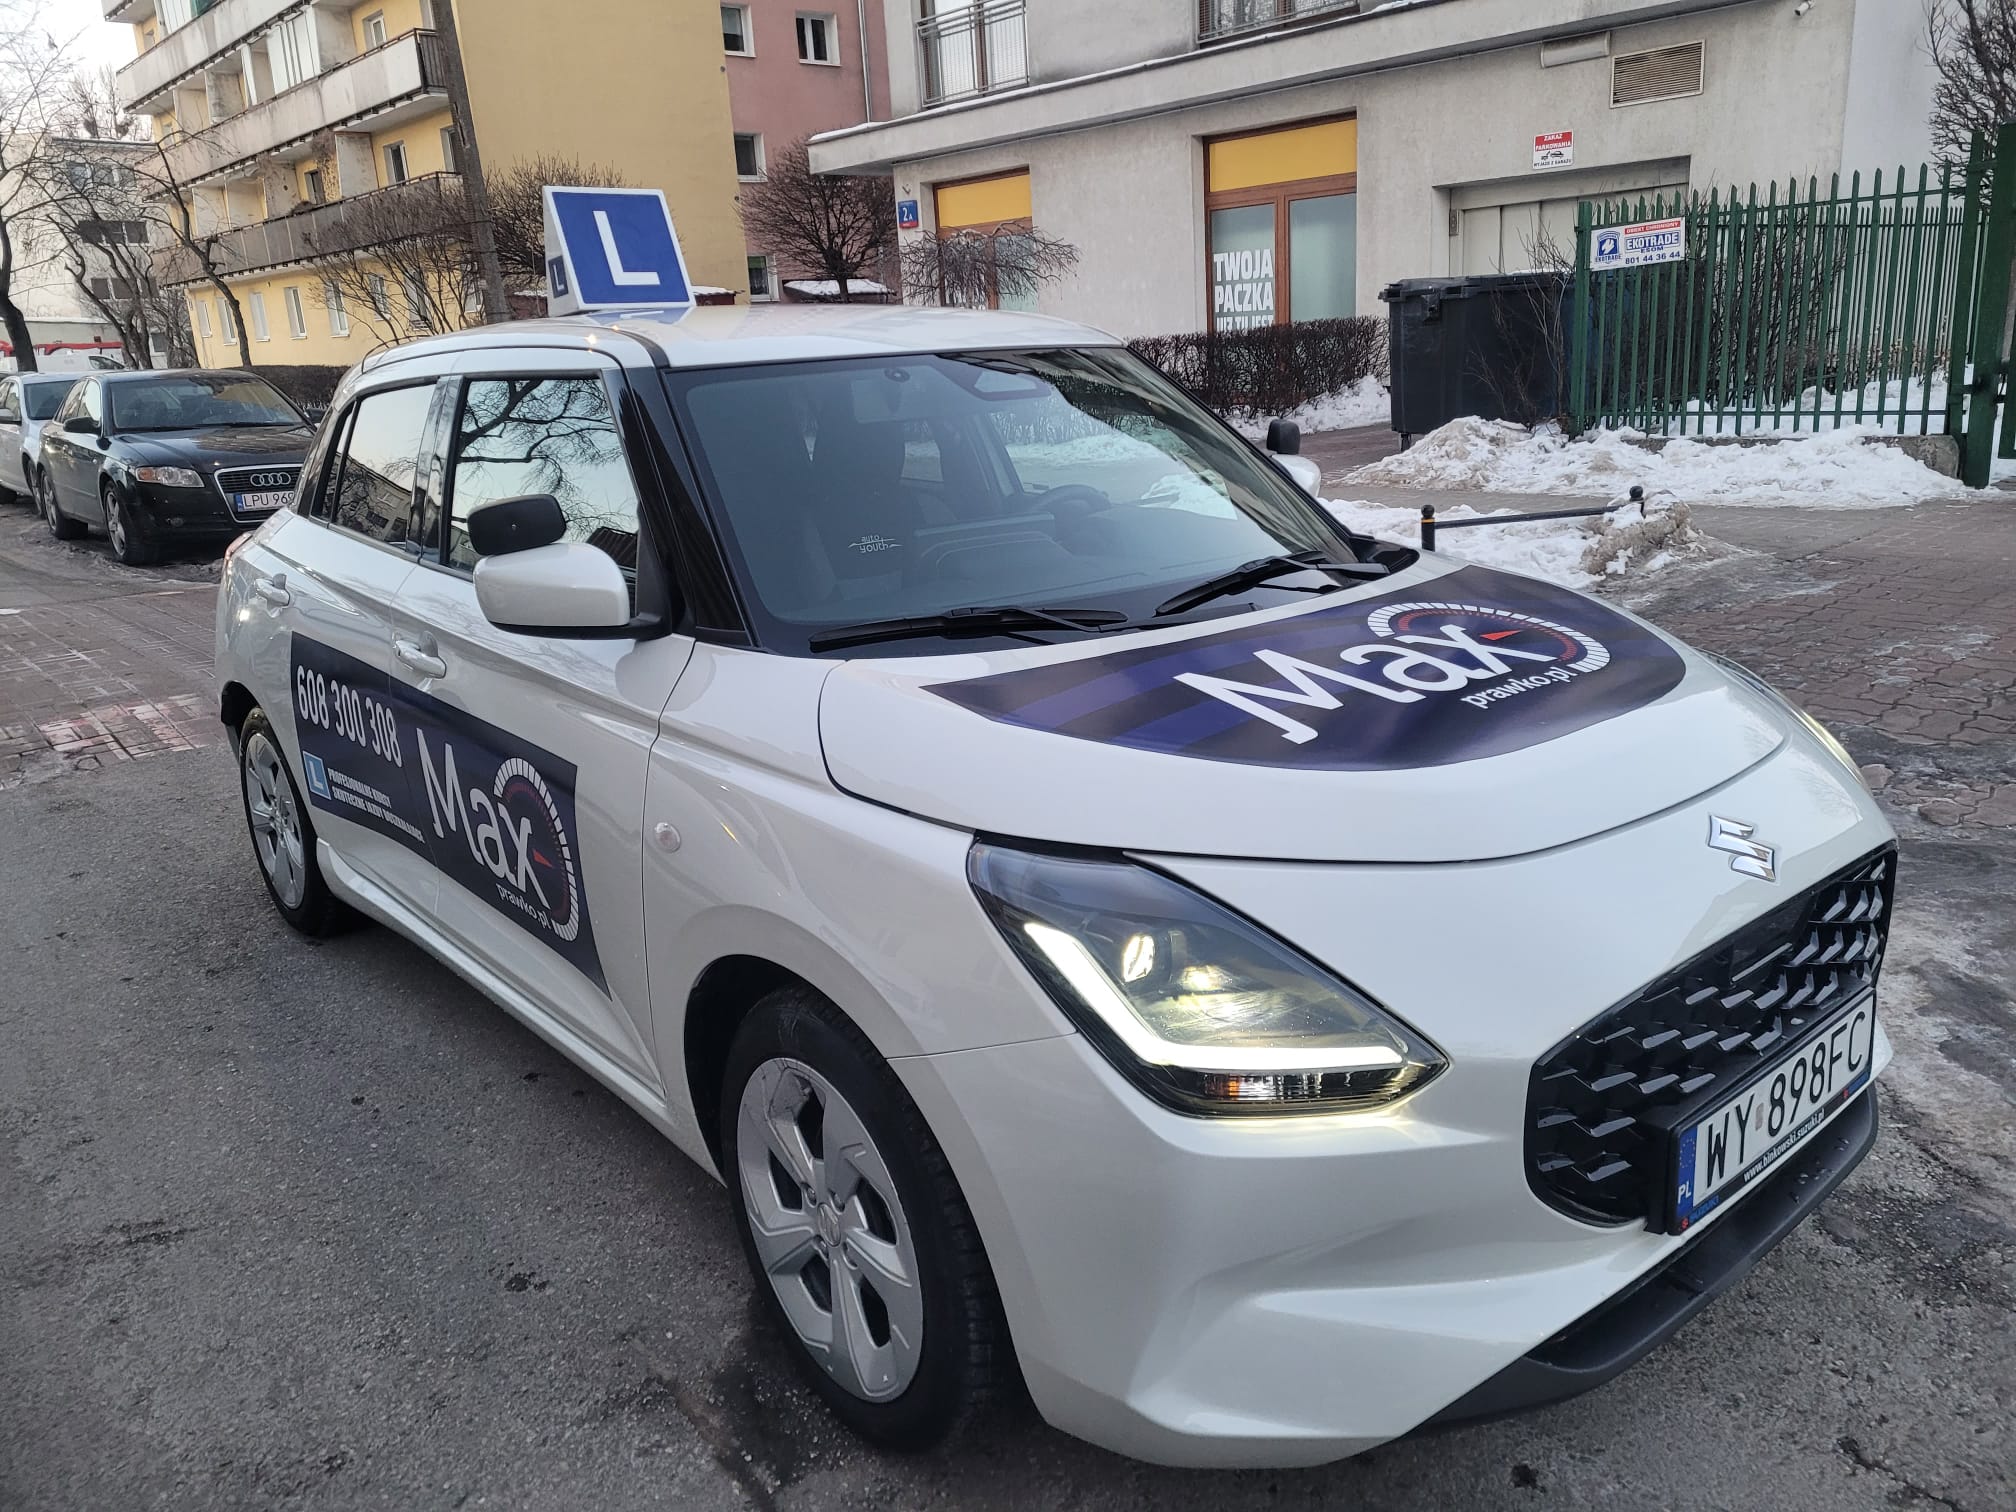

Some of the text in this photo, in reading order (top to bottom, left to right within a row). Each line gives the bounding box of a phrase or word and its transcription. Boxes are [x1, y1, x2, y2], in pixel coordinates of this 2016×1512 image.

[593, 210, 661, 286] L
[1627, 233, 1679, 249] EKOTRADE
[1641, 245, 1664, 254] ESOM
[1213, 248, 1274, 282] TWOJA
[1625, 250, 1681, 265] 801 44 36 44
[553, 263, 565, 291] L
[1214, 281, 1274, 313] PACZKA
[243, 492, 269, 508] LPU
[859, 537, 889, 553] youth
[1172, 623, 1558, 745] Max
[1459, 665, 1579, 710] prawko.pl
[297, 664, 402, 768] 608 300 308
[308, 760, 325, 791] L
[416, 727, 551, 909] Max
[495, 882, 552, 929] prawko.pl
[1706, 1010, 1866, 1189] WY 898FC
[1677, 1179, 1692, 1205] PL
